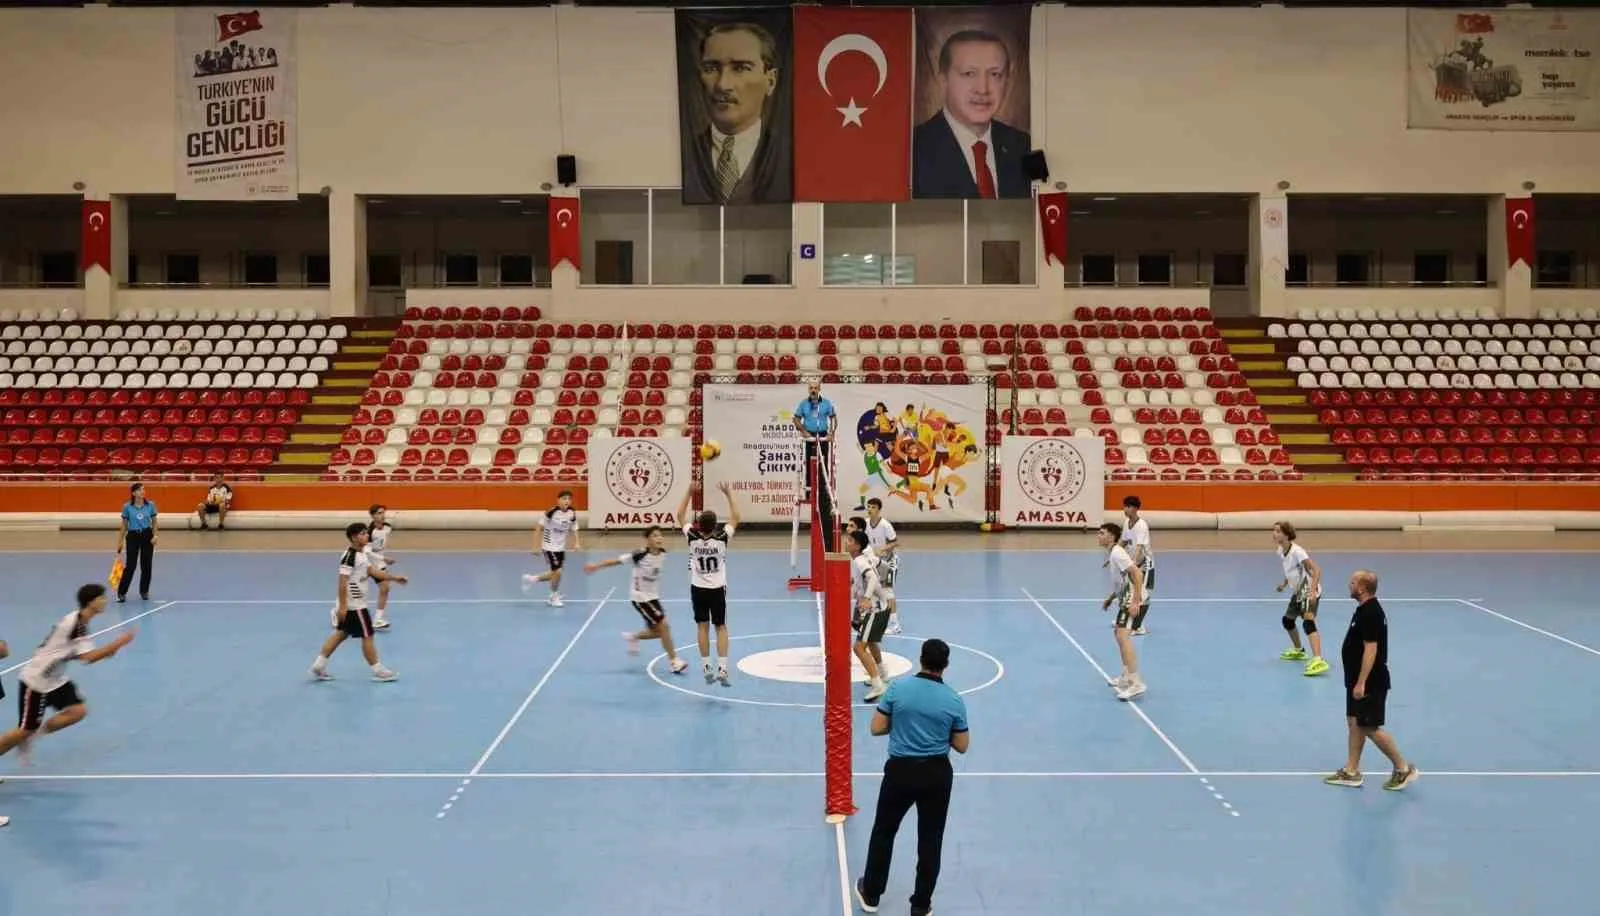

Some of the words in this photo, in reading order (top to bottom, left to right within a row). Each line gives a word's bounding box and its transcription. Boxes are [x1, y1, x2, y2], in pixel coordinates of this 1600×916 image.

[206, 96, 266, 127] GÜCÜ
[186, 120, 285, 157] GENÇLİĞİ
[804, 247, 812, 256] C
[771, 507, 794, 516] AMASY
[1016, 510, 1087, 522] AMASYA
[604, 512, 675, 524] AMASYA
[697, 556, 718, 573] 10
